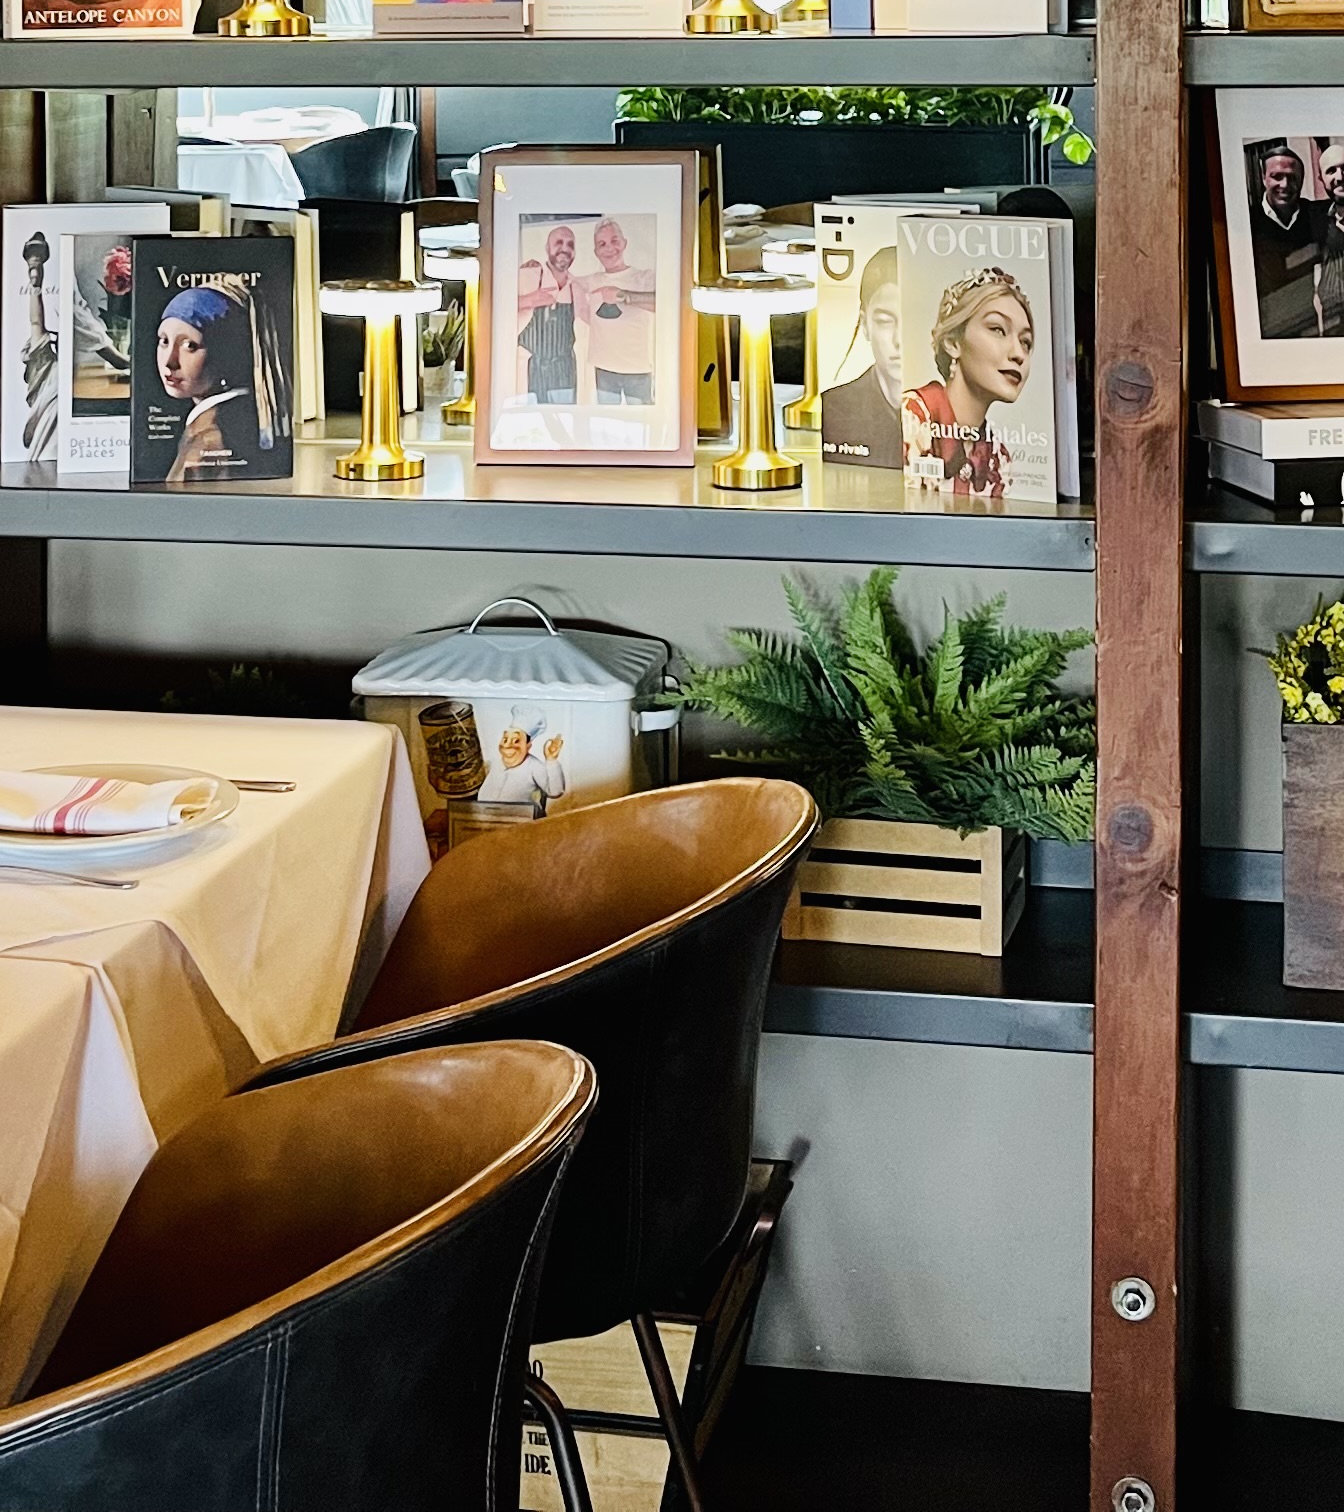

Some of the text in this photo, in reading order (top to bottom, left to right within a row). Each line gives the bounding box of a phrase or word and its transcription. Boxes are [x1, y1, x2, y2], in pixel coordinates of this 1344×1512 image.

[24, 7, 181, 26] ANTELOPE CANYON
[899, 221, 1047, 261] VOGUE
[156, 265, 262, 289] Vermeer
[984, 414, 1050, 448] fatales
[69, 437, 131, 450] Deliciou
[838, 441, 871, 458] rivals
[69, 447, 116, 459] Places
[1027, 451, 1049, 466] ans
